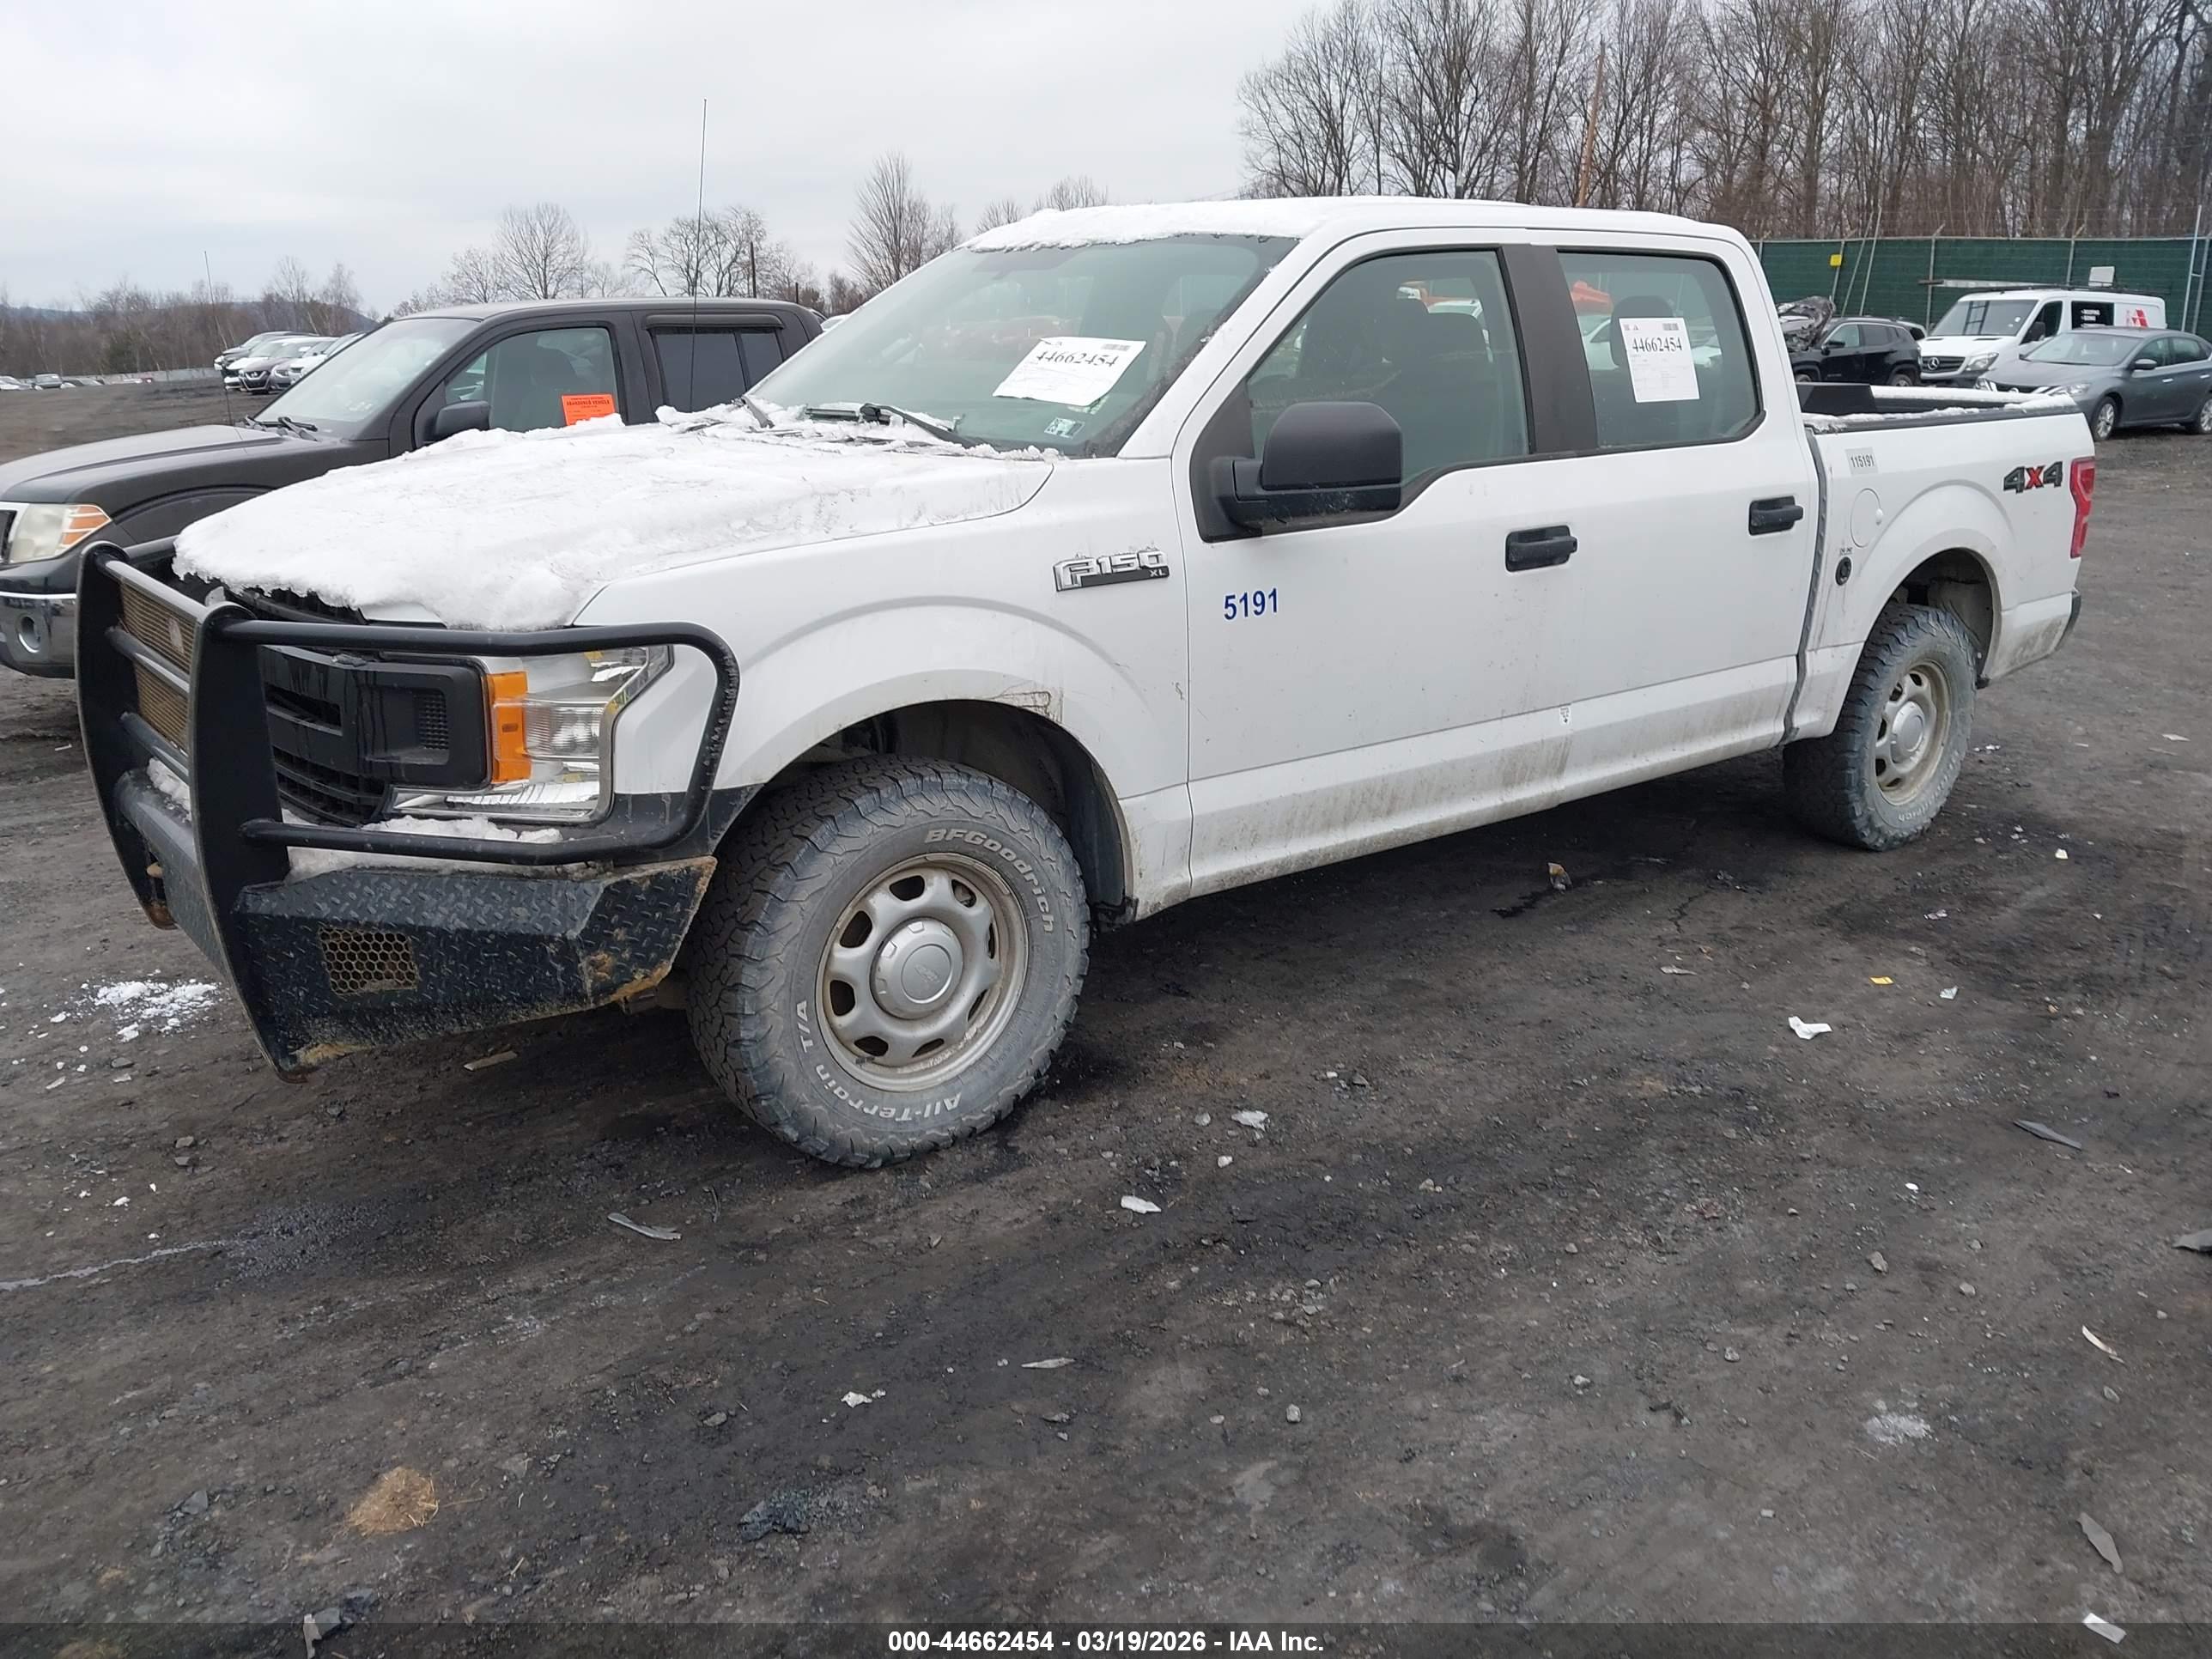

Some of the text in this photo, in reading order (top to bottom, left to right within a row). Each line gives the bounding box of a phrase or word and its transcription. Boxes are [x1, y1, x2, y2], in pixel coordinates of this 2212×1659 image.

[1632, 337, 1682, 352] 44662454
[1036, 351, 1118, 367] 44662454
[1850, 453, 1875, 468] 115191
[1149, 568, 1165, 577] XL
[1224, 587, 1278, 620] 5191
